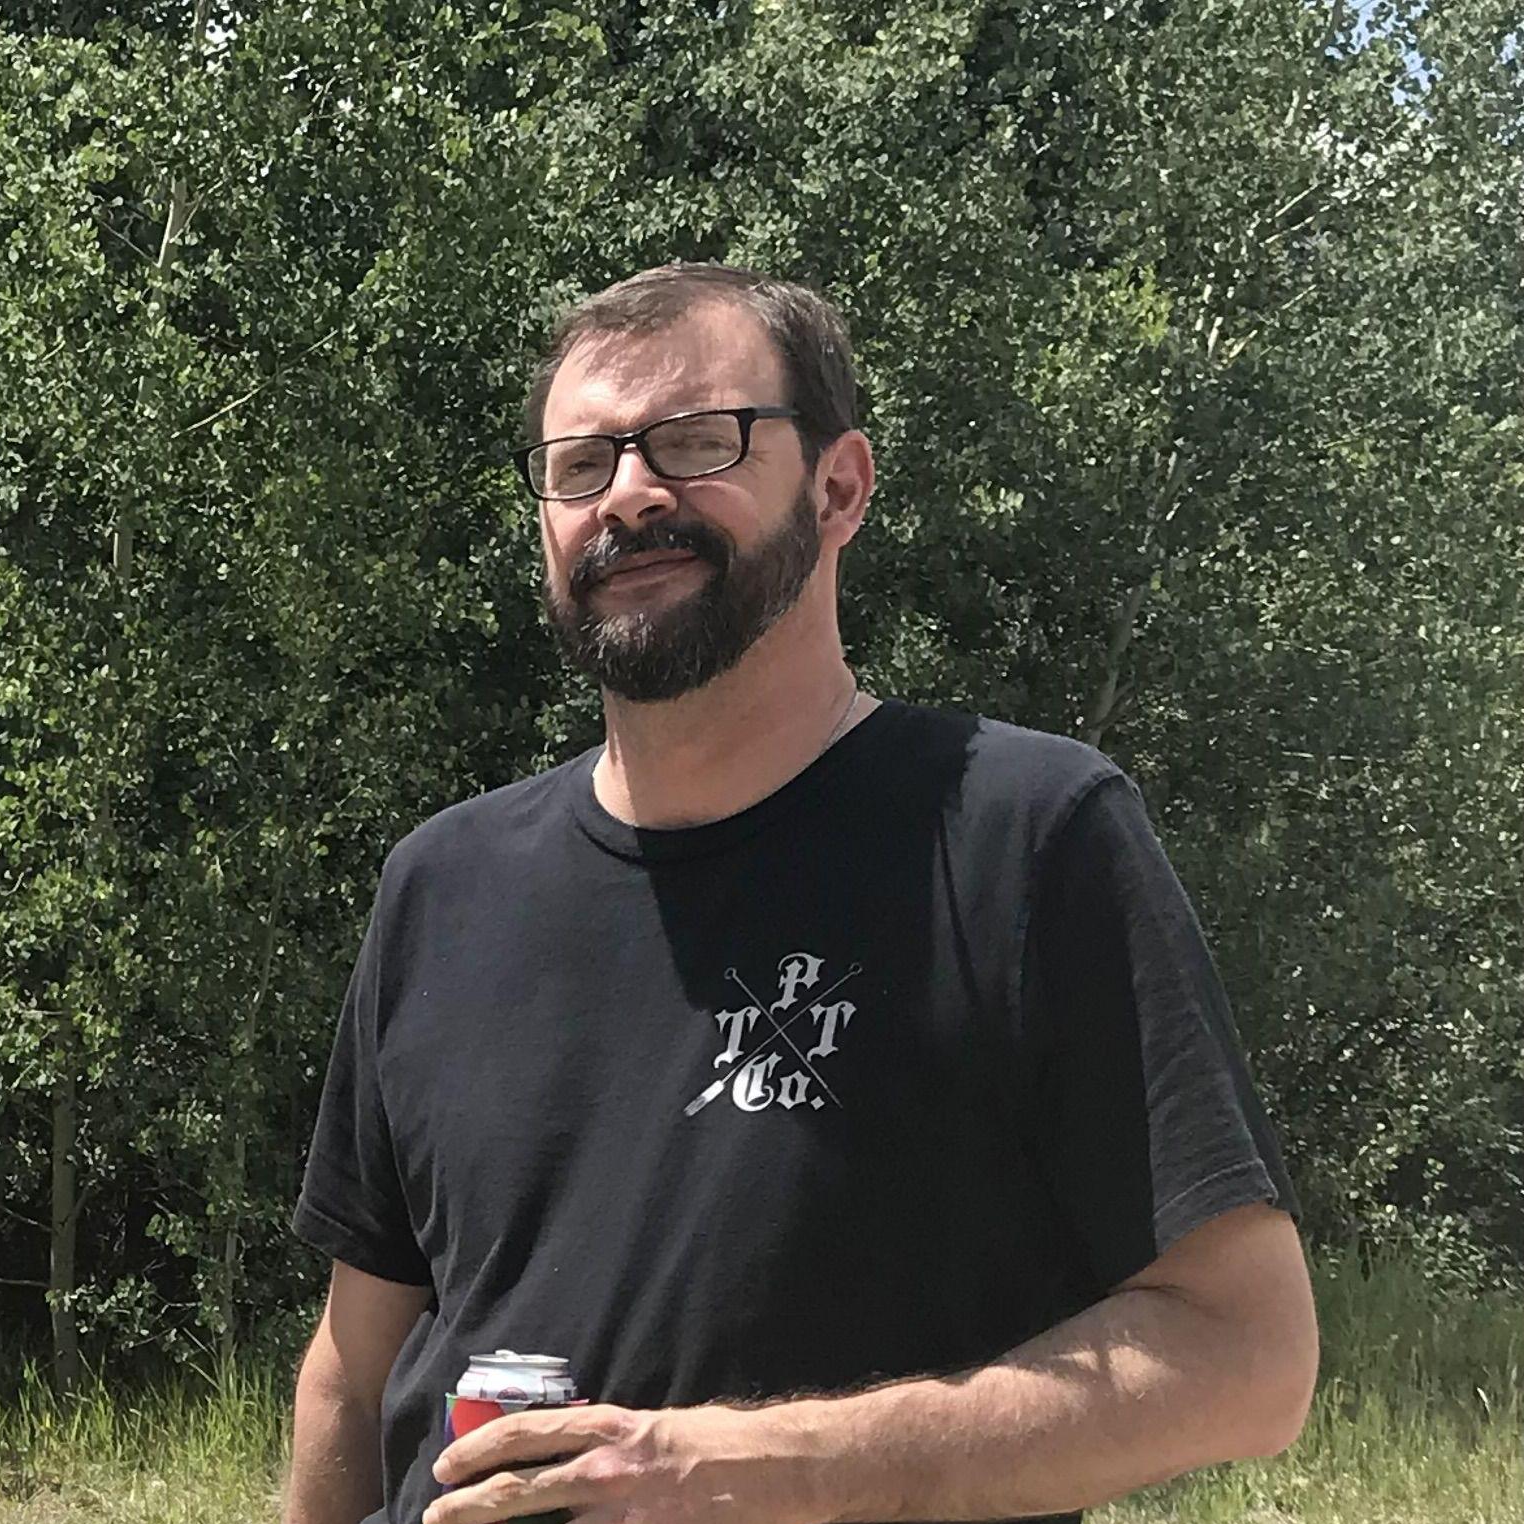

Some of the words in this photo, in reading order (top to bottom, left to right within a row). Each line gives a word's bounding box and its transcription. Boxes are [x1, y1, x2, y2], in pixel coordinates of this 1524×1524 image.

[770, 952, 826, 1015] P
[713, 1006, 761, 1069] T
[806, 1001, 857, 1062] T
[732, 1052, 825, 1112] Co.
